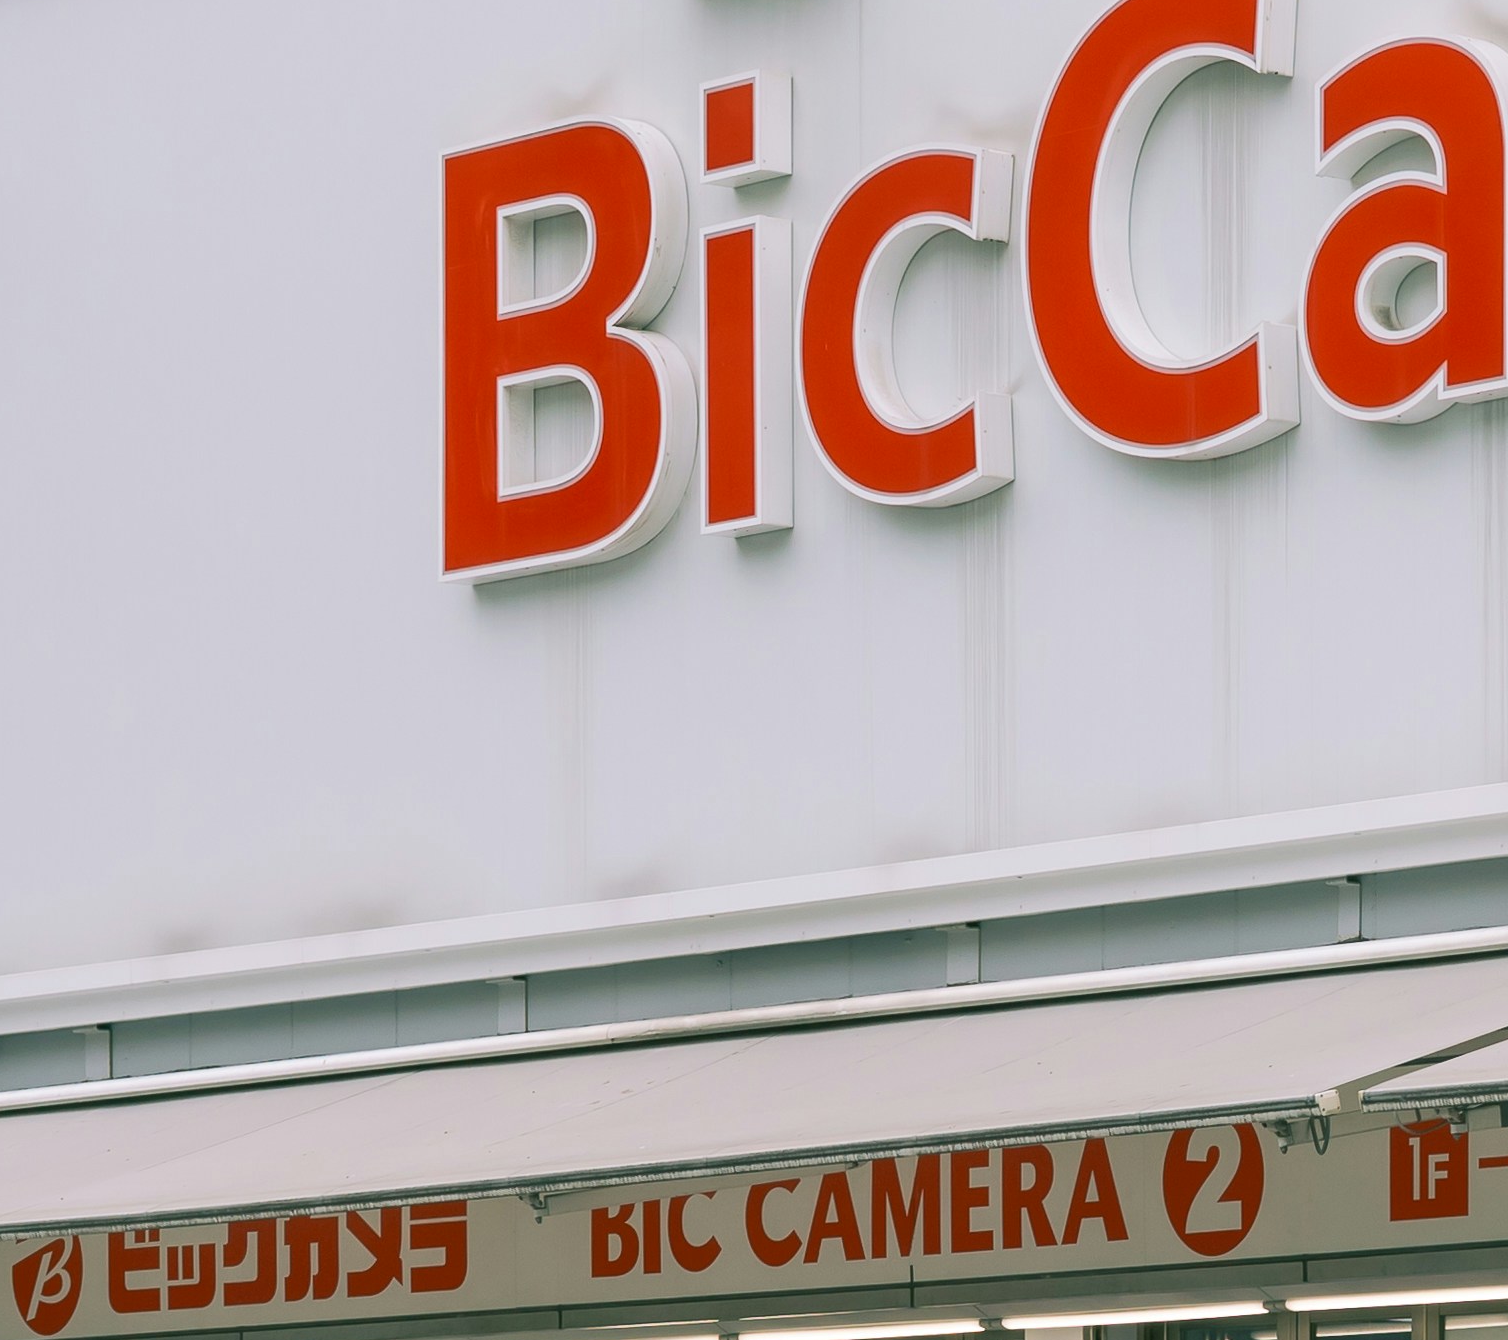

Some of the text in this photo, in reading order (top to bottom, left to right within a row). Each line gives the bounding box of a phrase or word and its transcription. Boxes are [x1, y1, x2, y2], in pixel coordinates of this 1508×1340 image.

[108, 1204, 468, 1315] ビックカメラ
[590, 1190, 719, 1277] BIC
[743, 1140, 1128, 1267] CAMERA
